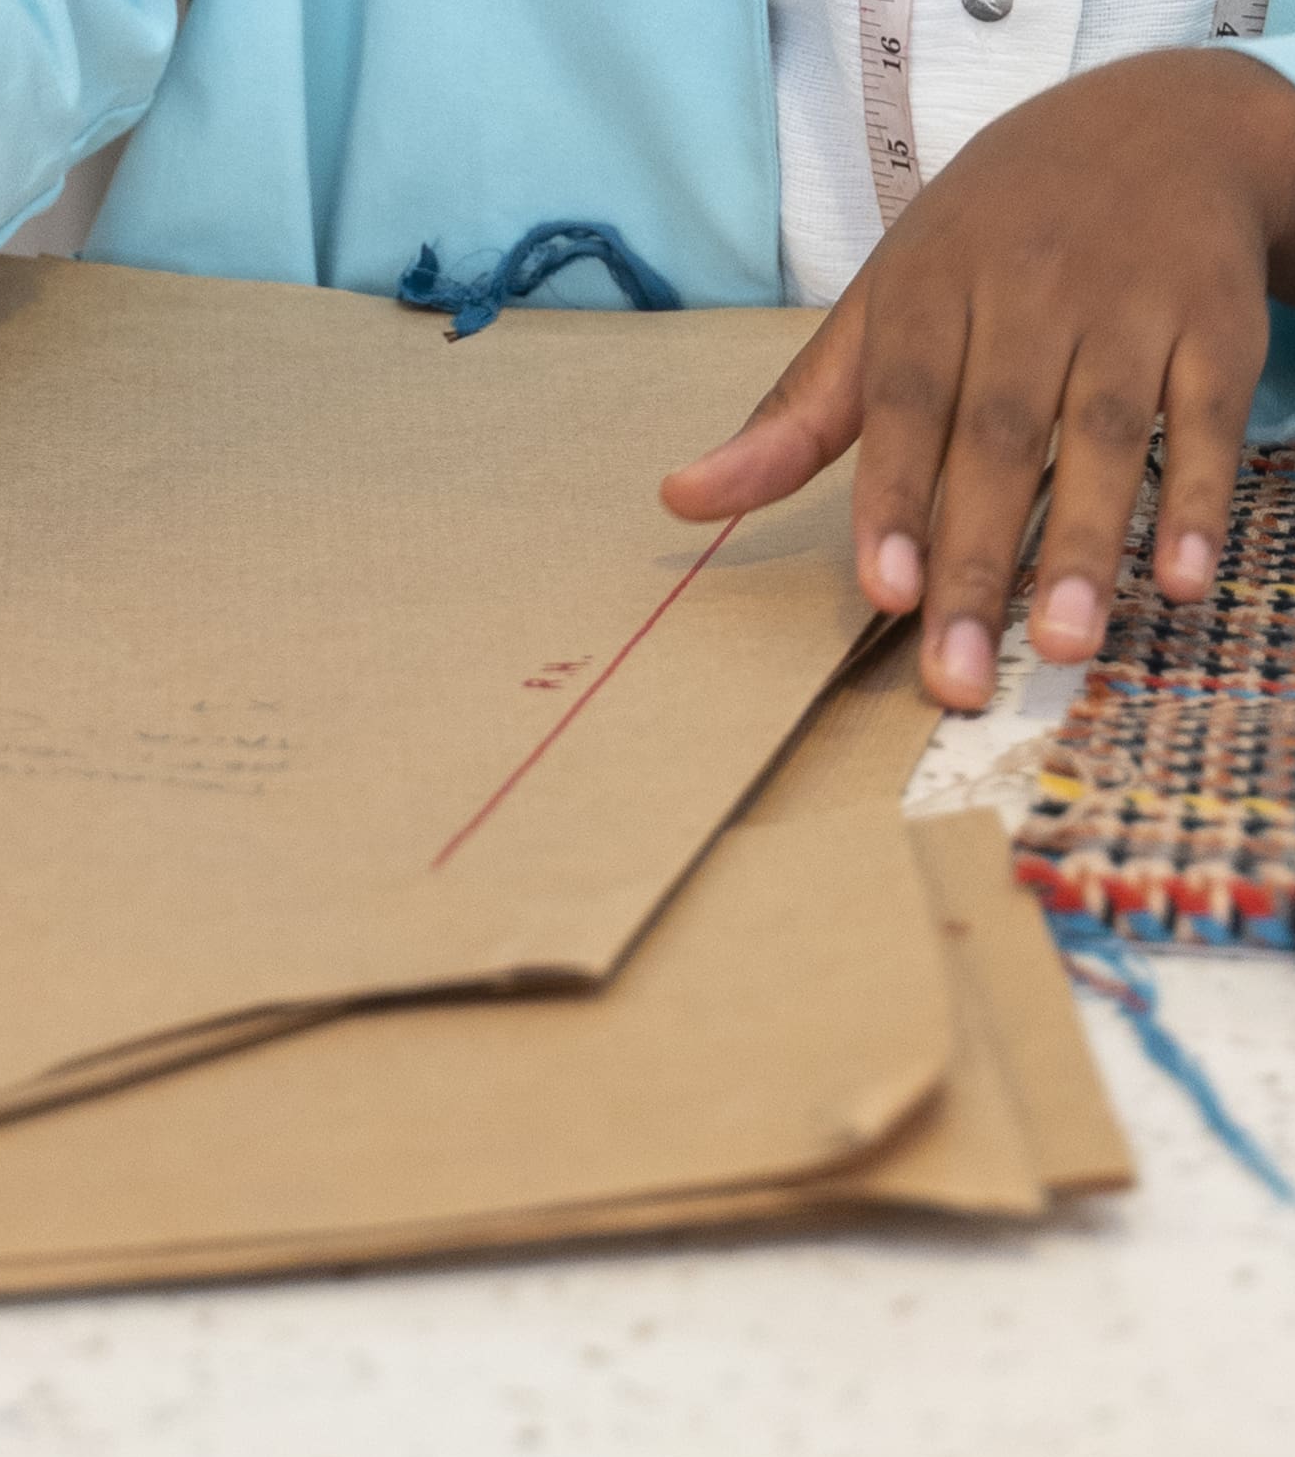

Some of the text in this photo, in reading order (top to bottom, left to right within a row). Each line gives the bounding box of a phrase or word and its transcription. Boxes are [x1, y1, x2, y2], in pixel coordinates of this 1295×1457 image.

[1217, 22, 1241, 39] 4
[881, 36, 901, 72] 16
[890, 139, 912, 172] 15
